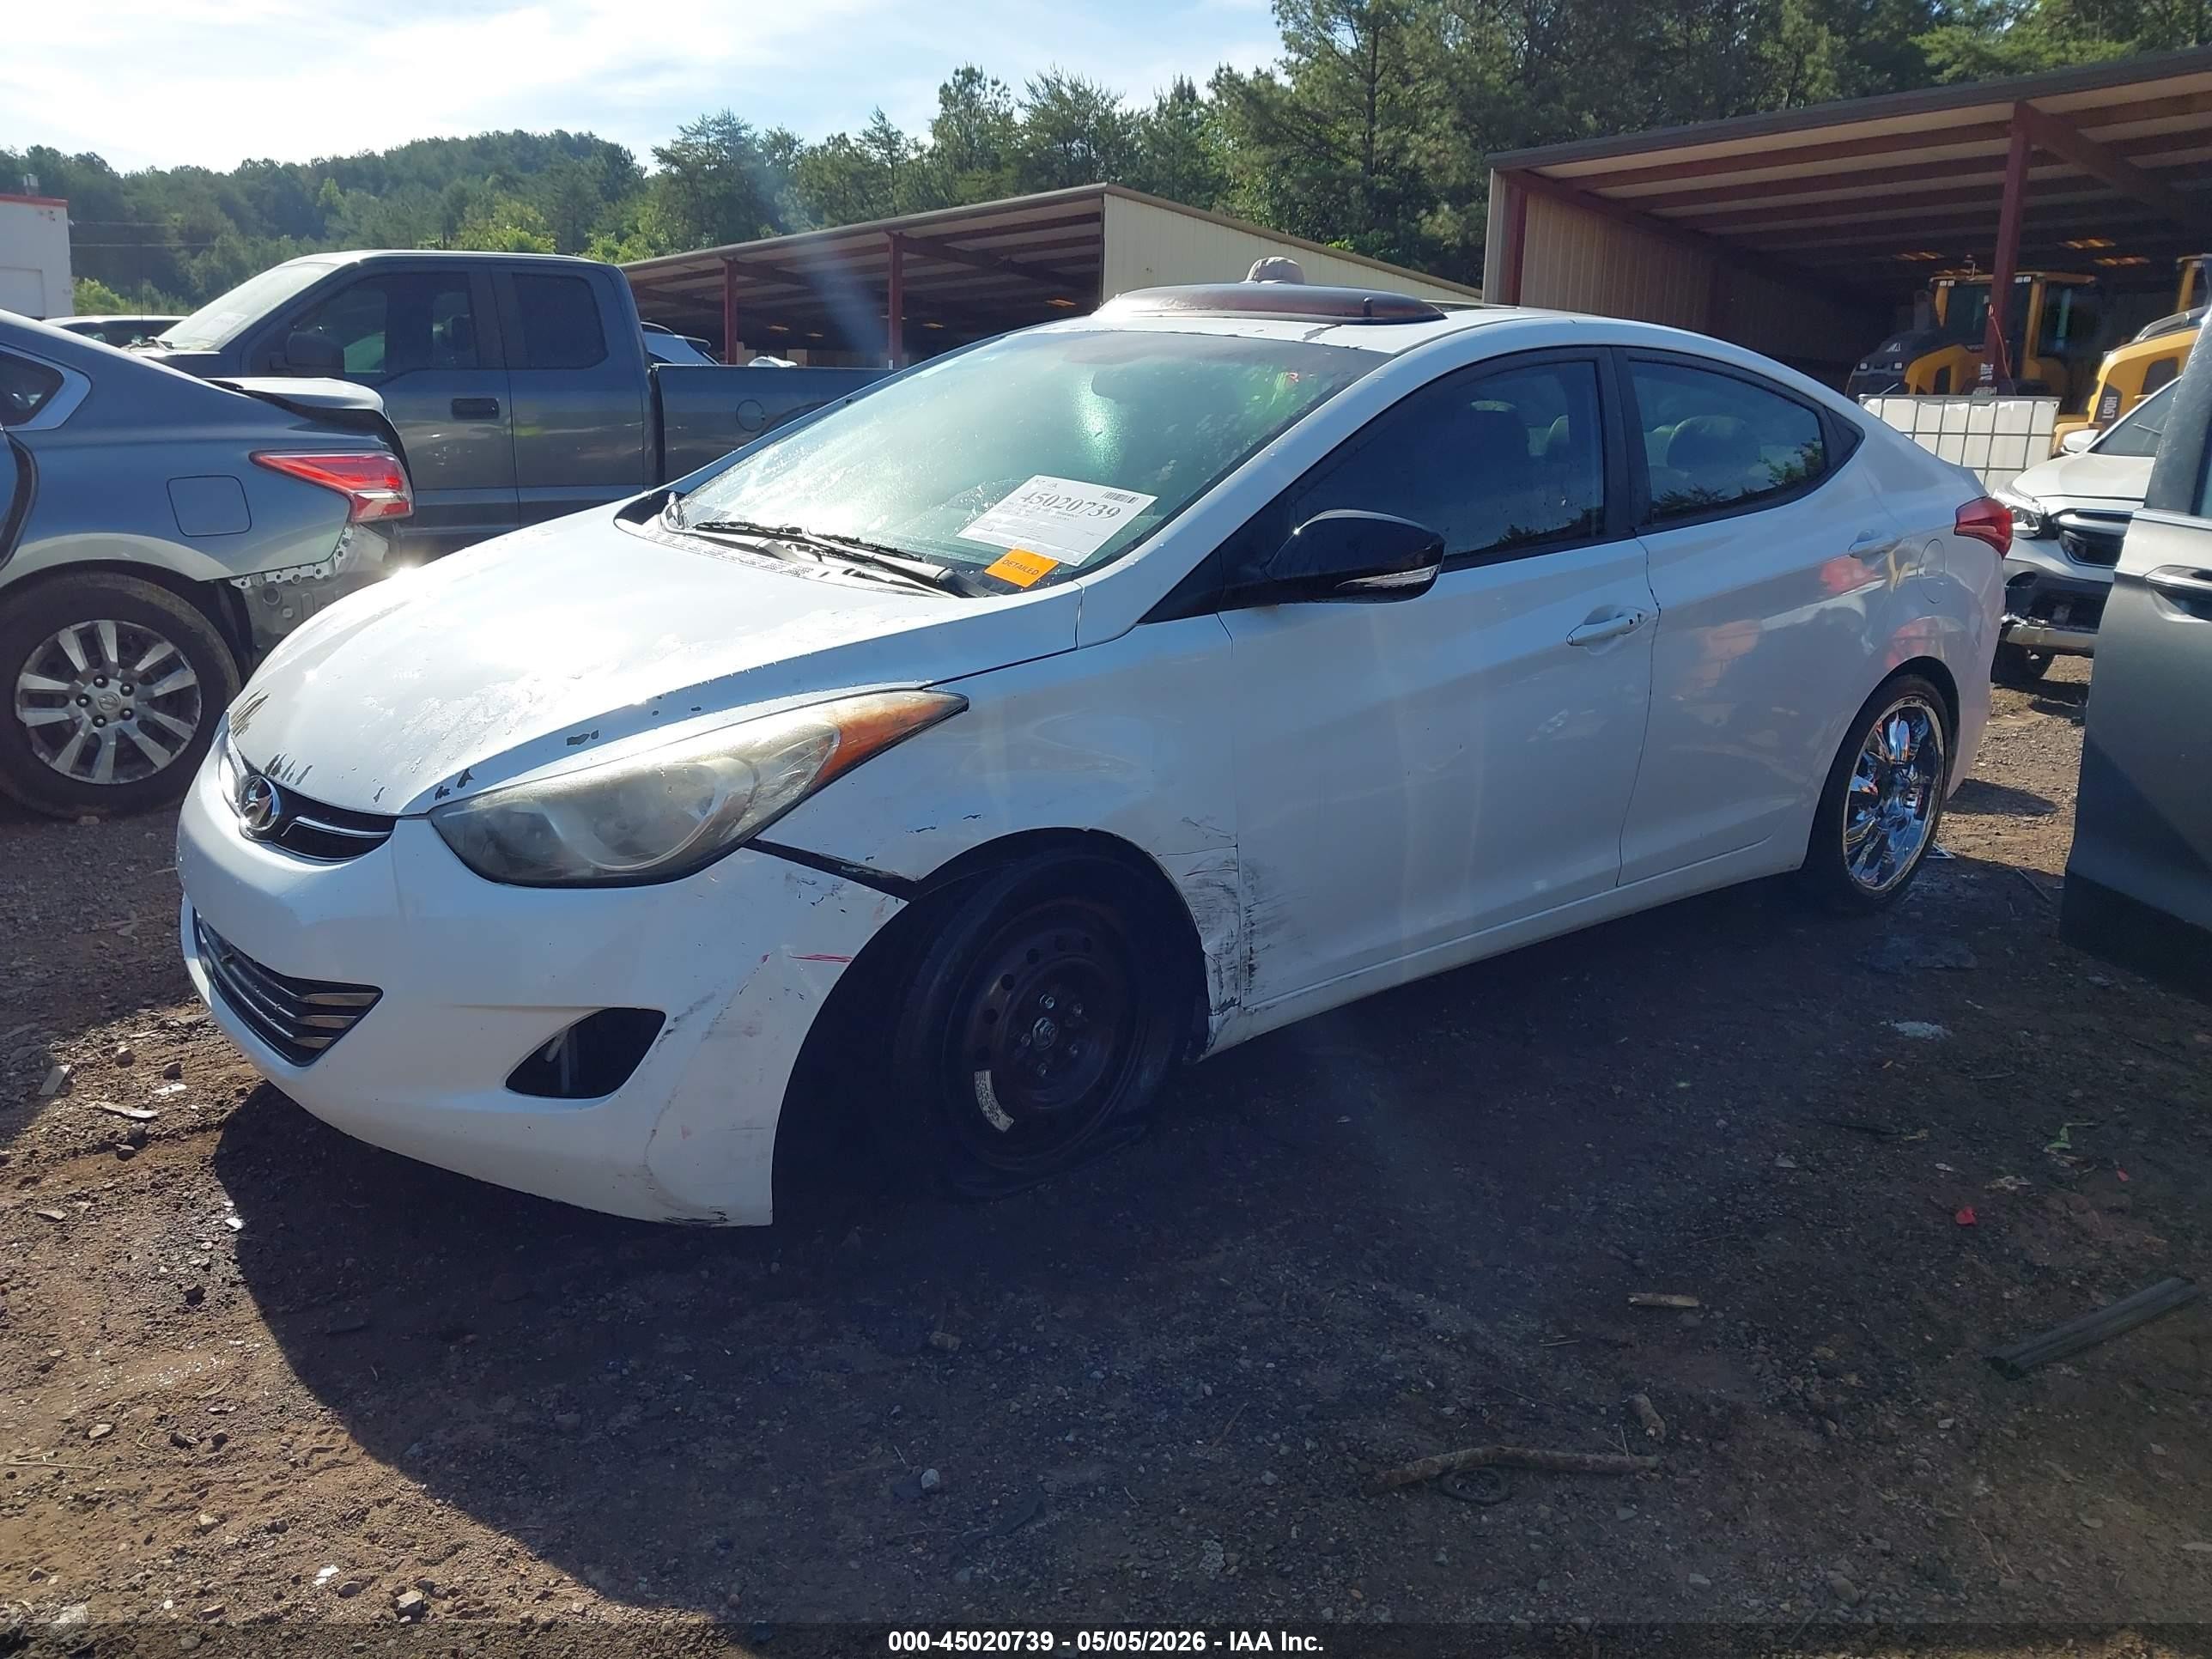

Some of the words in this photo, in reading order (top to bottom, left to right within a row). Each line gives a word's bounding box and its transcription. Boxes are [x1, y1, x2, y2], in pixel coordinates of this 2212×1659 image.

[2102, 396, 2118, 419] L90H
[1020, 491, 1121, 518] 45020739
[1002, 559, 1039, 575] DETAILED
